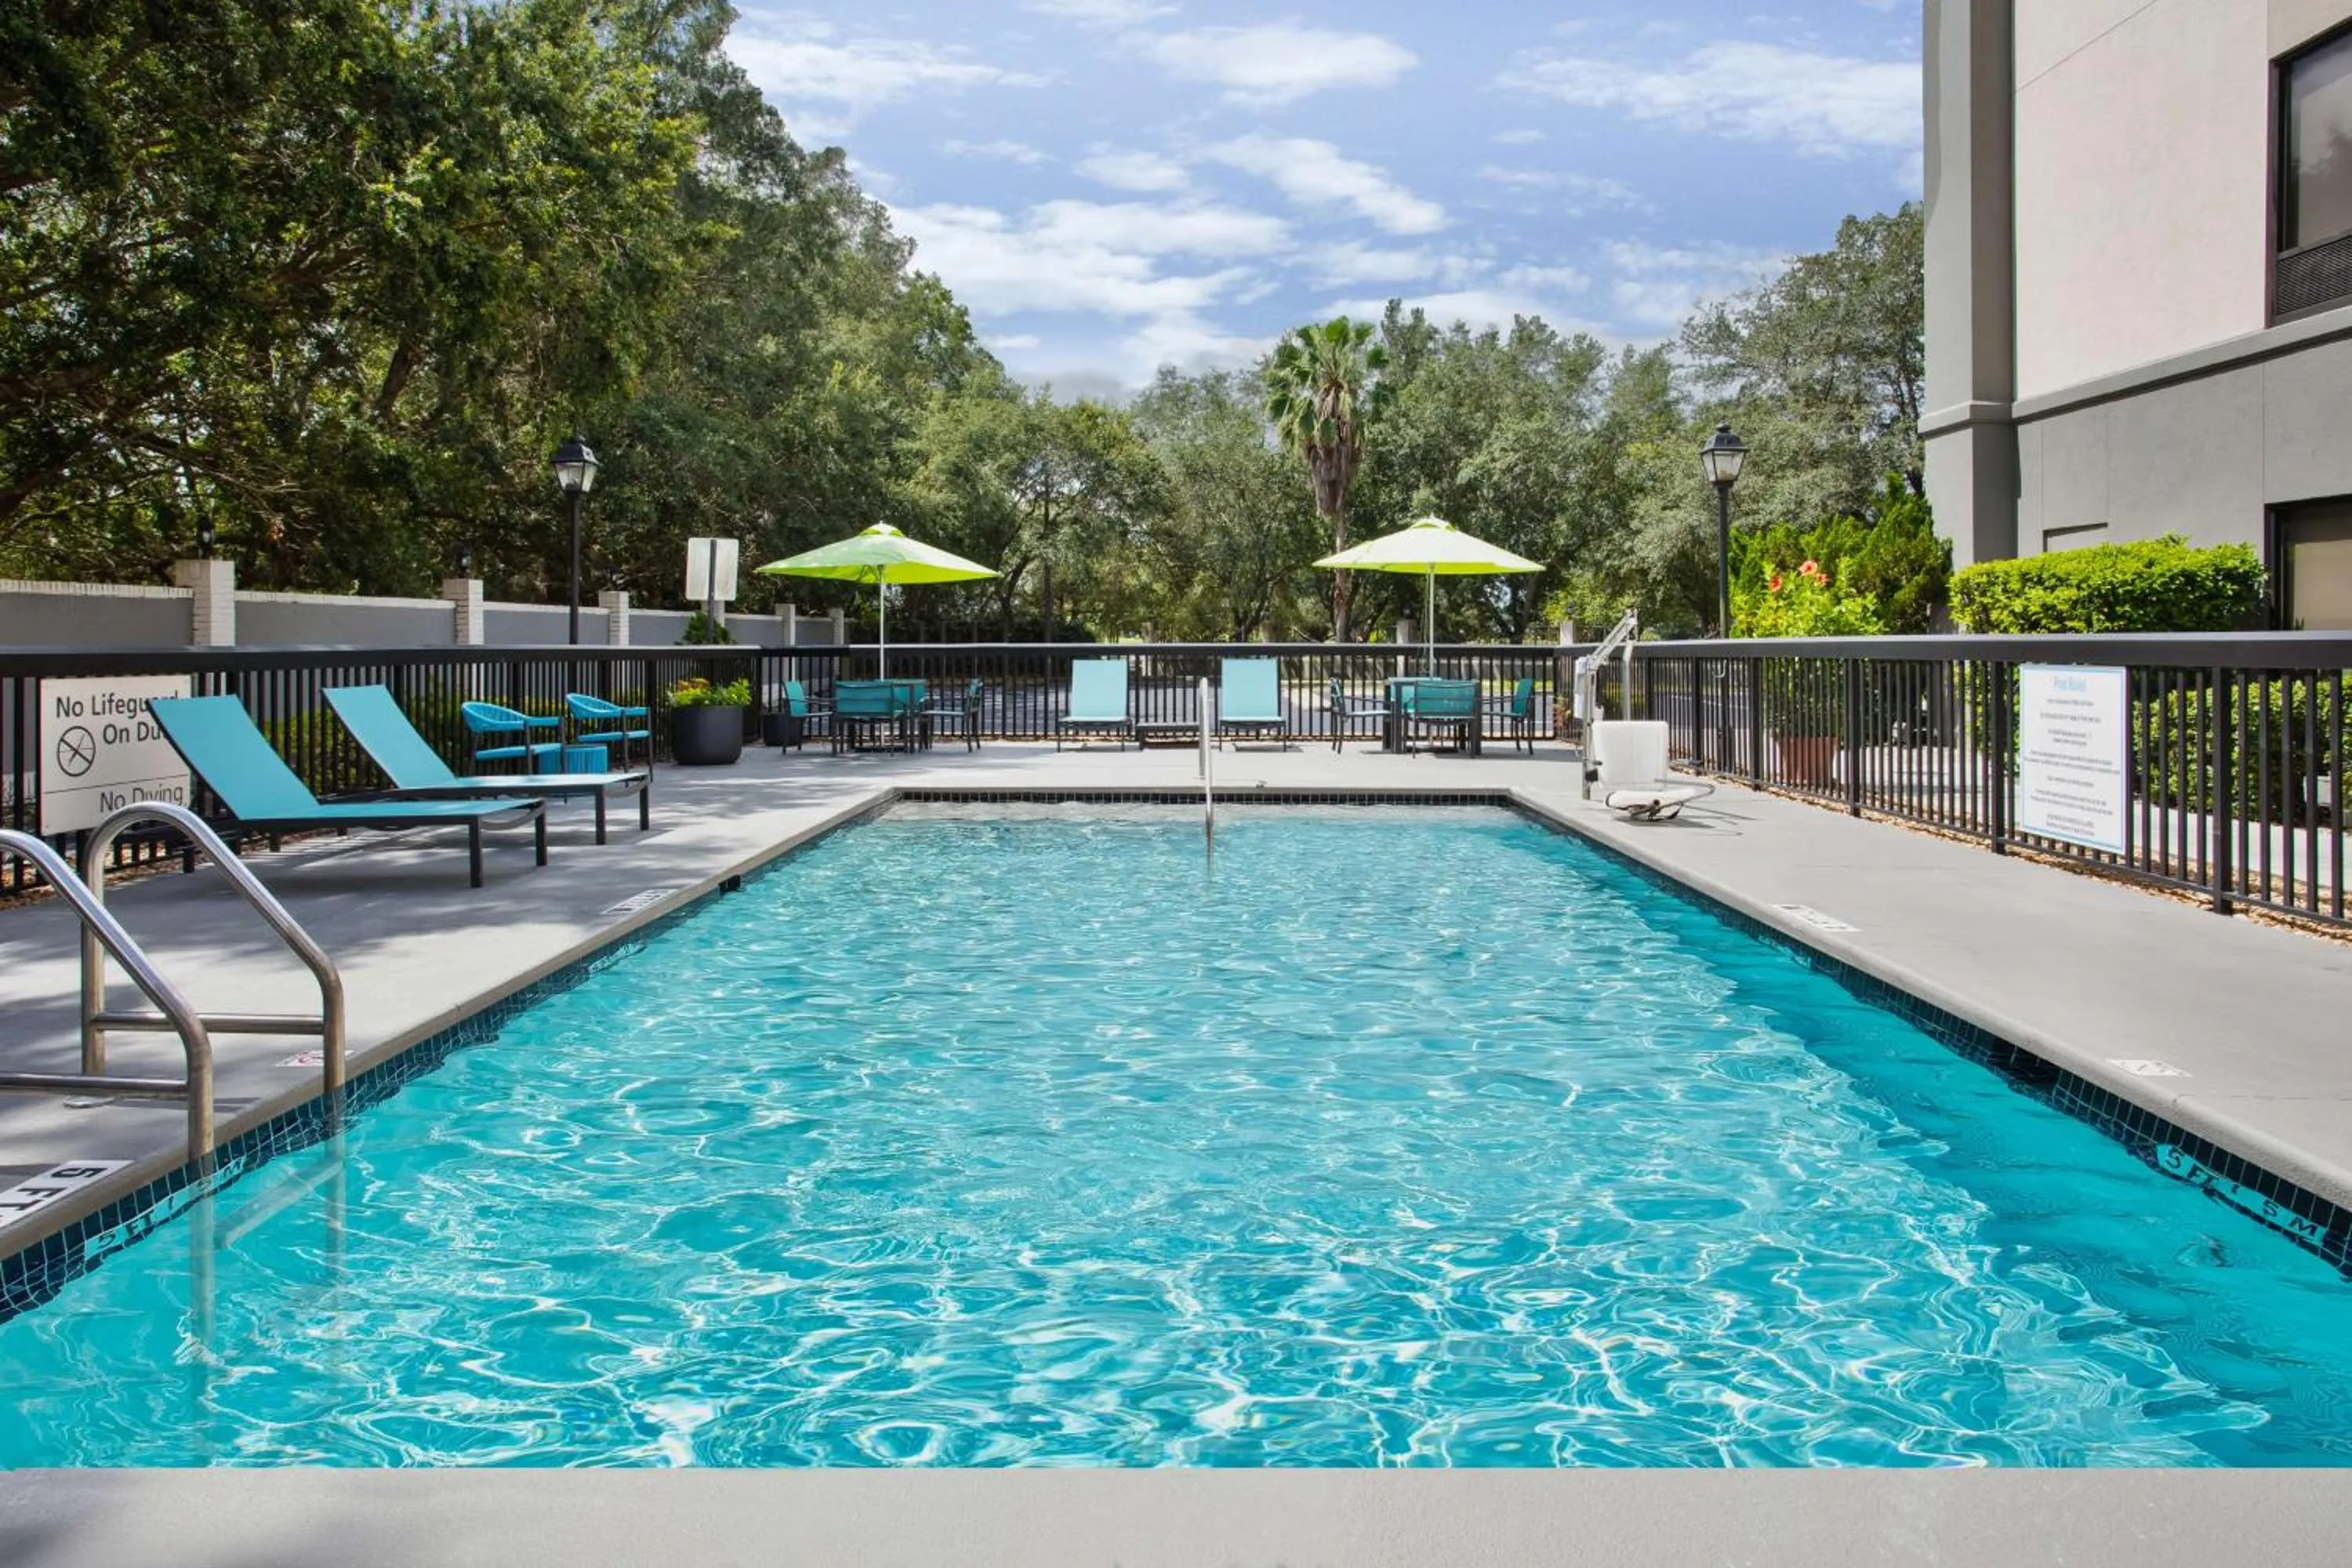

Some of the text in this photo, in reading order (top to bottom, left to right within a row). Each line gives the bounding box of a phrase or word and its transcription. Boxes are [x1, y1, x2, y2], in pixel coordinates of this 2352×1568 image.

[56, 690, 177, 719] No Lifegu
[103, 724, 129, 744] On
[100, 790, 125, 813] No
[0, 1167, 108, 1210] 5 FT
[2165, 1146, 2185, 1168] 5
[2288, 1216, 2318, 1236] M
